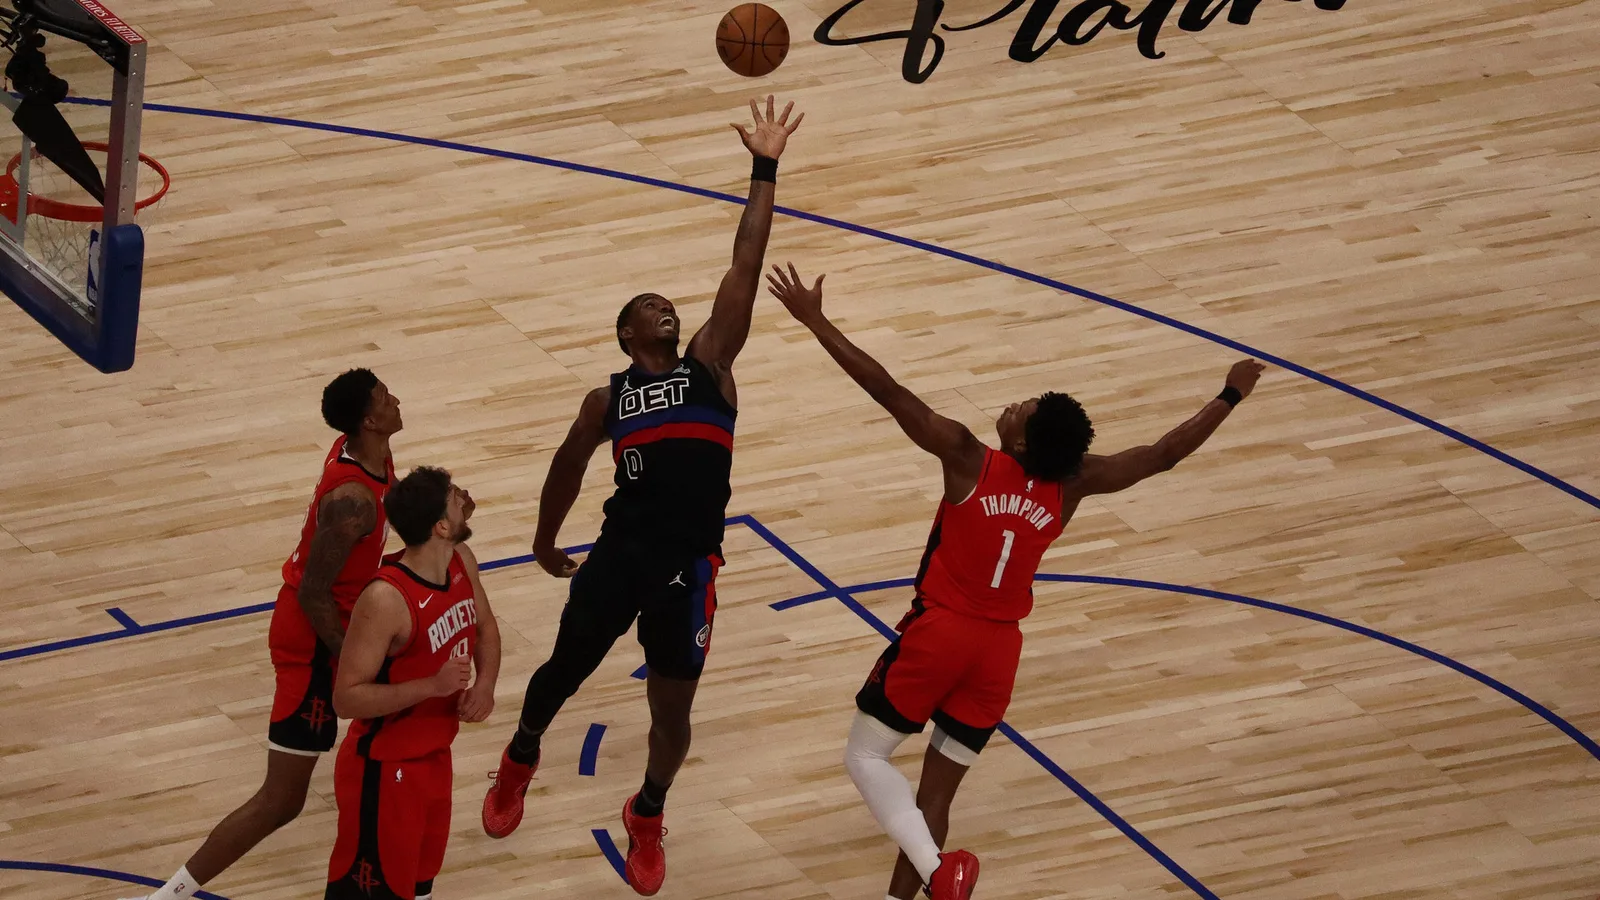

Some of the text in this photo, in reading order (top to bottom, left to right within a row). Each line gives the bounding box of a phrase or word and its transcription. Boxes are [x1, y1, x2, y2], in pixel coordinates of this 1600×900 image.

[79, 0, 109, 17] rates
[619, 377, 690, 420] DET
[623, 447, 644, 480] 0
[979, 493, 1055, 531] THOMPSON
[990, 529, 1015, 589] 1
[427, 598, 477, 654] ROCKETS
